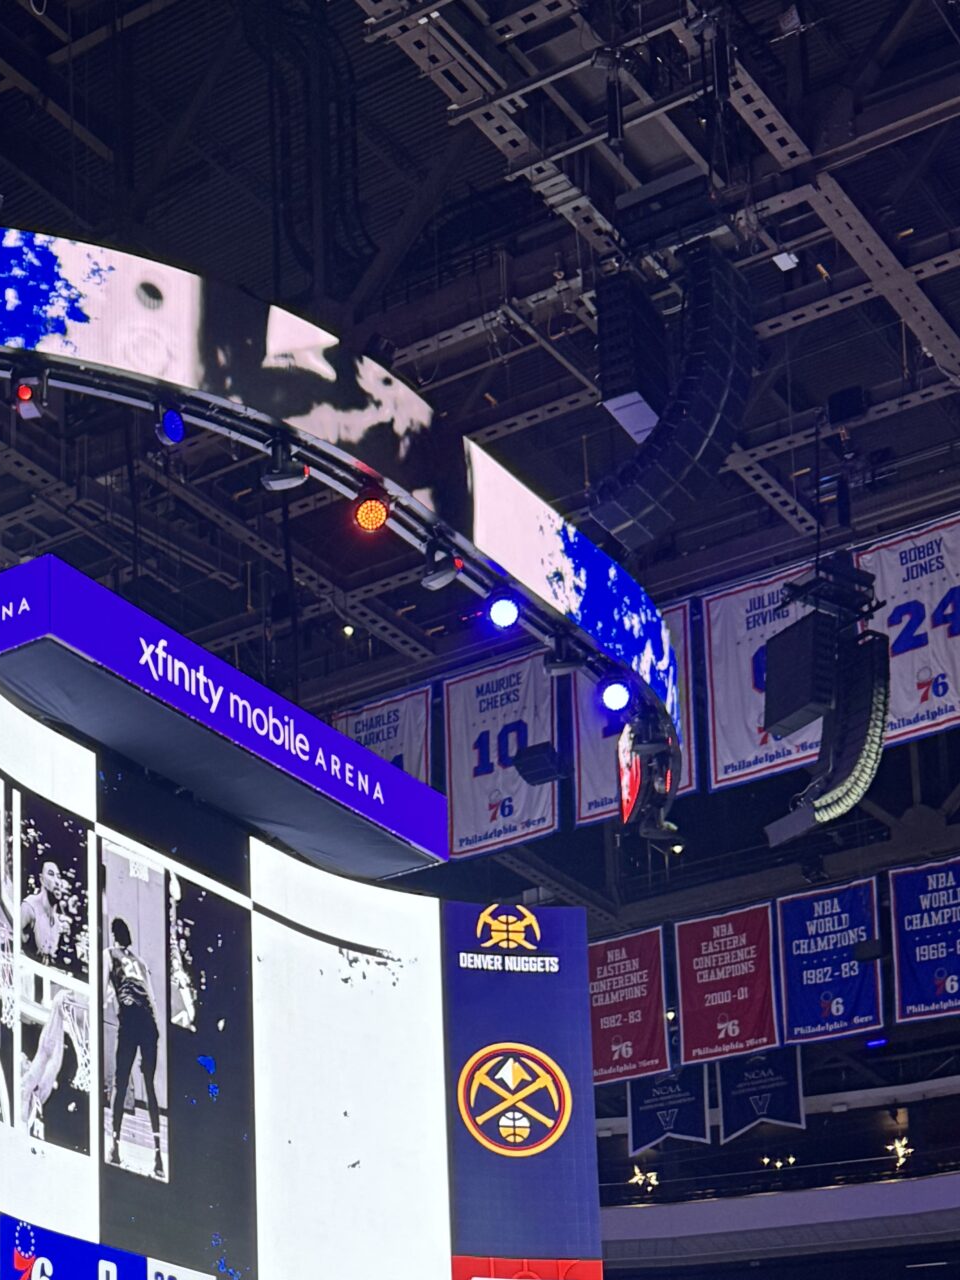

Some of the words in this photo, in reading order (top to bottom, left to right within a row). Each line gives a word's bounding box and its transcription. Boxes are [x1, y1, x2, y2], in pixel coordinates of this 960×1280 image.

[899, 537, 943, 566] BOBBY
[902, 555, 945, 583] JONES
[746, 608, 789, 630] ERVING
[887, 585, 960, 658] 24
[475, 671, 522, 698] MAURICE
[916, 673, 949, 704] 76
[479, 689, 520, 713] CHEEKS
[139, 637, 224, 714] xfinity
[230, 692, 310, 761] mobile
[315, 747, 385, 805] ARENA
[354, 709, 400, 734] CHARLES
[473, 720, 529, 778] 10
[724, 748, 792, 775] Philadelphia
[488, 797, 513, 822] 76
[459, 825, 517, 847] Philadelphia
[928, 871, 956, 890] NBA
[813, 898, 841, 917] NBA
[712, 923, 734, 939] NBA
[806, 913, 849, 936] WORLD
[701, 933, 746, 954] EASTERN
[792, 926, 867, 955] CHAMPIONS
[459, 952, 501, 971] DENVER
[505, 953, 559, 973] NUGGETS
[607, 948, 627, 963] NBA
[693, 945, 757, 970] CONFERENCE
[597, 958, 640, 979] EASTERN
[697, 961, 755, 983] CHAMPIONS
[803, 961, 859, 985] 1982-83
[590, 970, 649, 994] CONFERENCE
[592, 984, 647, 1007] CHAMPIONS
[705, 987, 748, 1006] 2000-01
[600, 1010, 642, 1029] 1982-83
[593, 1061, 637, 1077] hiladelphia
